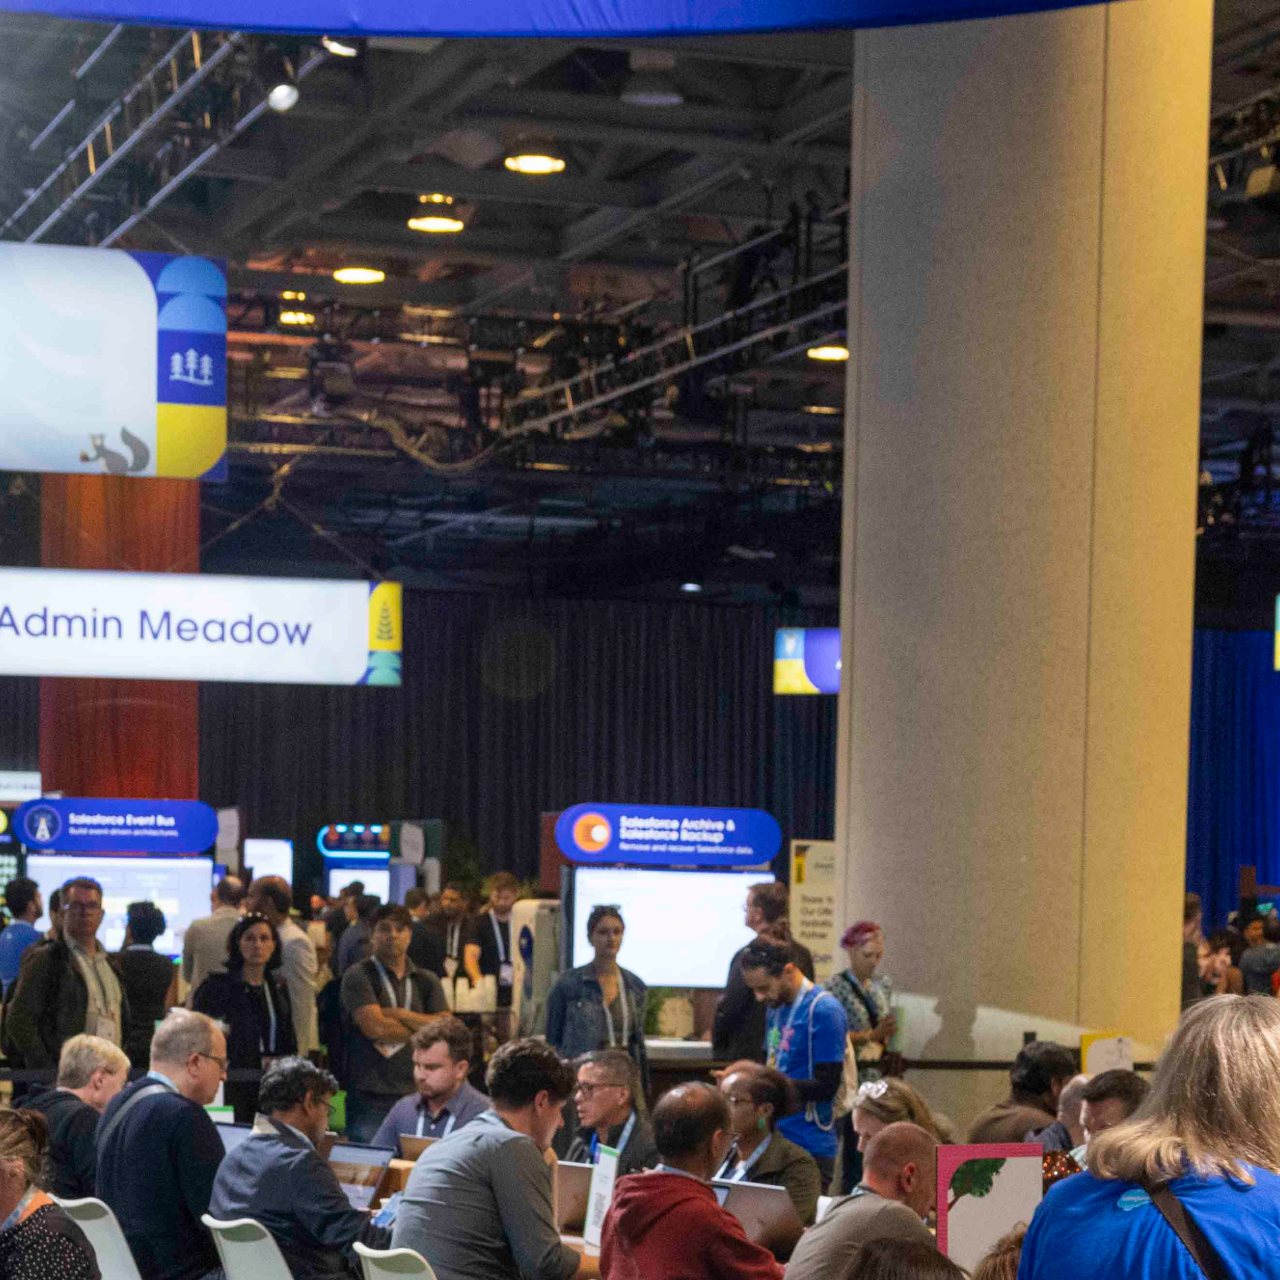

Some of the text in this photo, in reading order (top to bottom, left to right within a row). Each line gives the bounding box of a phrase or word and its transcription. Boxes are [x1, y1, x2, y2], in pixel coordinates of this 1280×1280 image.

[138, 608, 313, 647] Meadow
[68, 812, 176, 827] Salesforce Event Bus
[620, 815, 736, 832] Salesforce Archive &
[620, 828, 725, 844] Salesforce Backup
[619, 842, 651, 851] Remove
